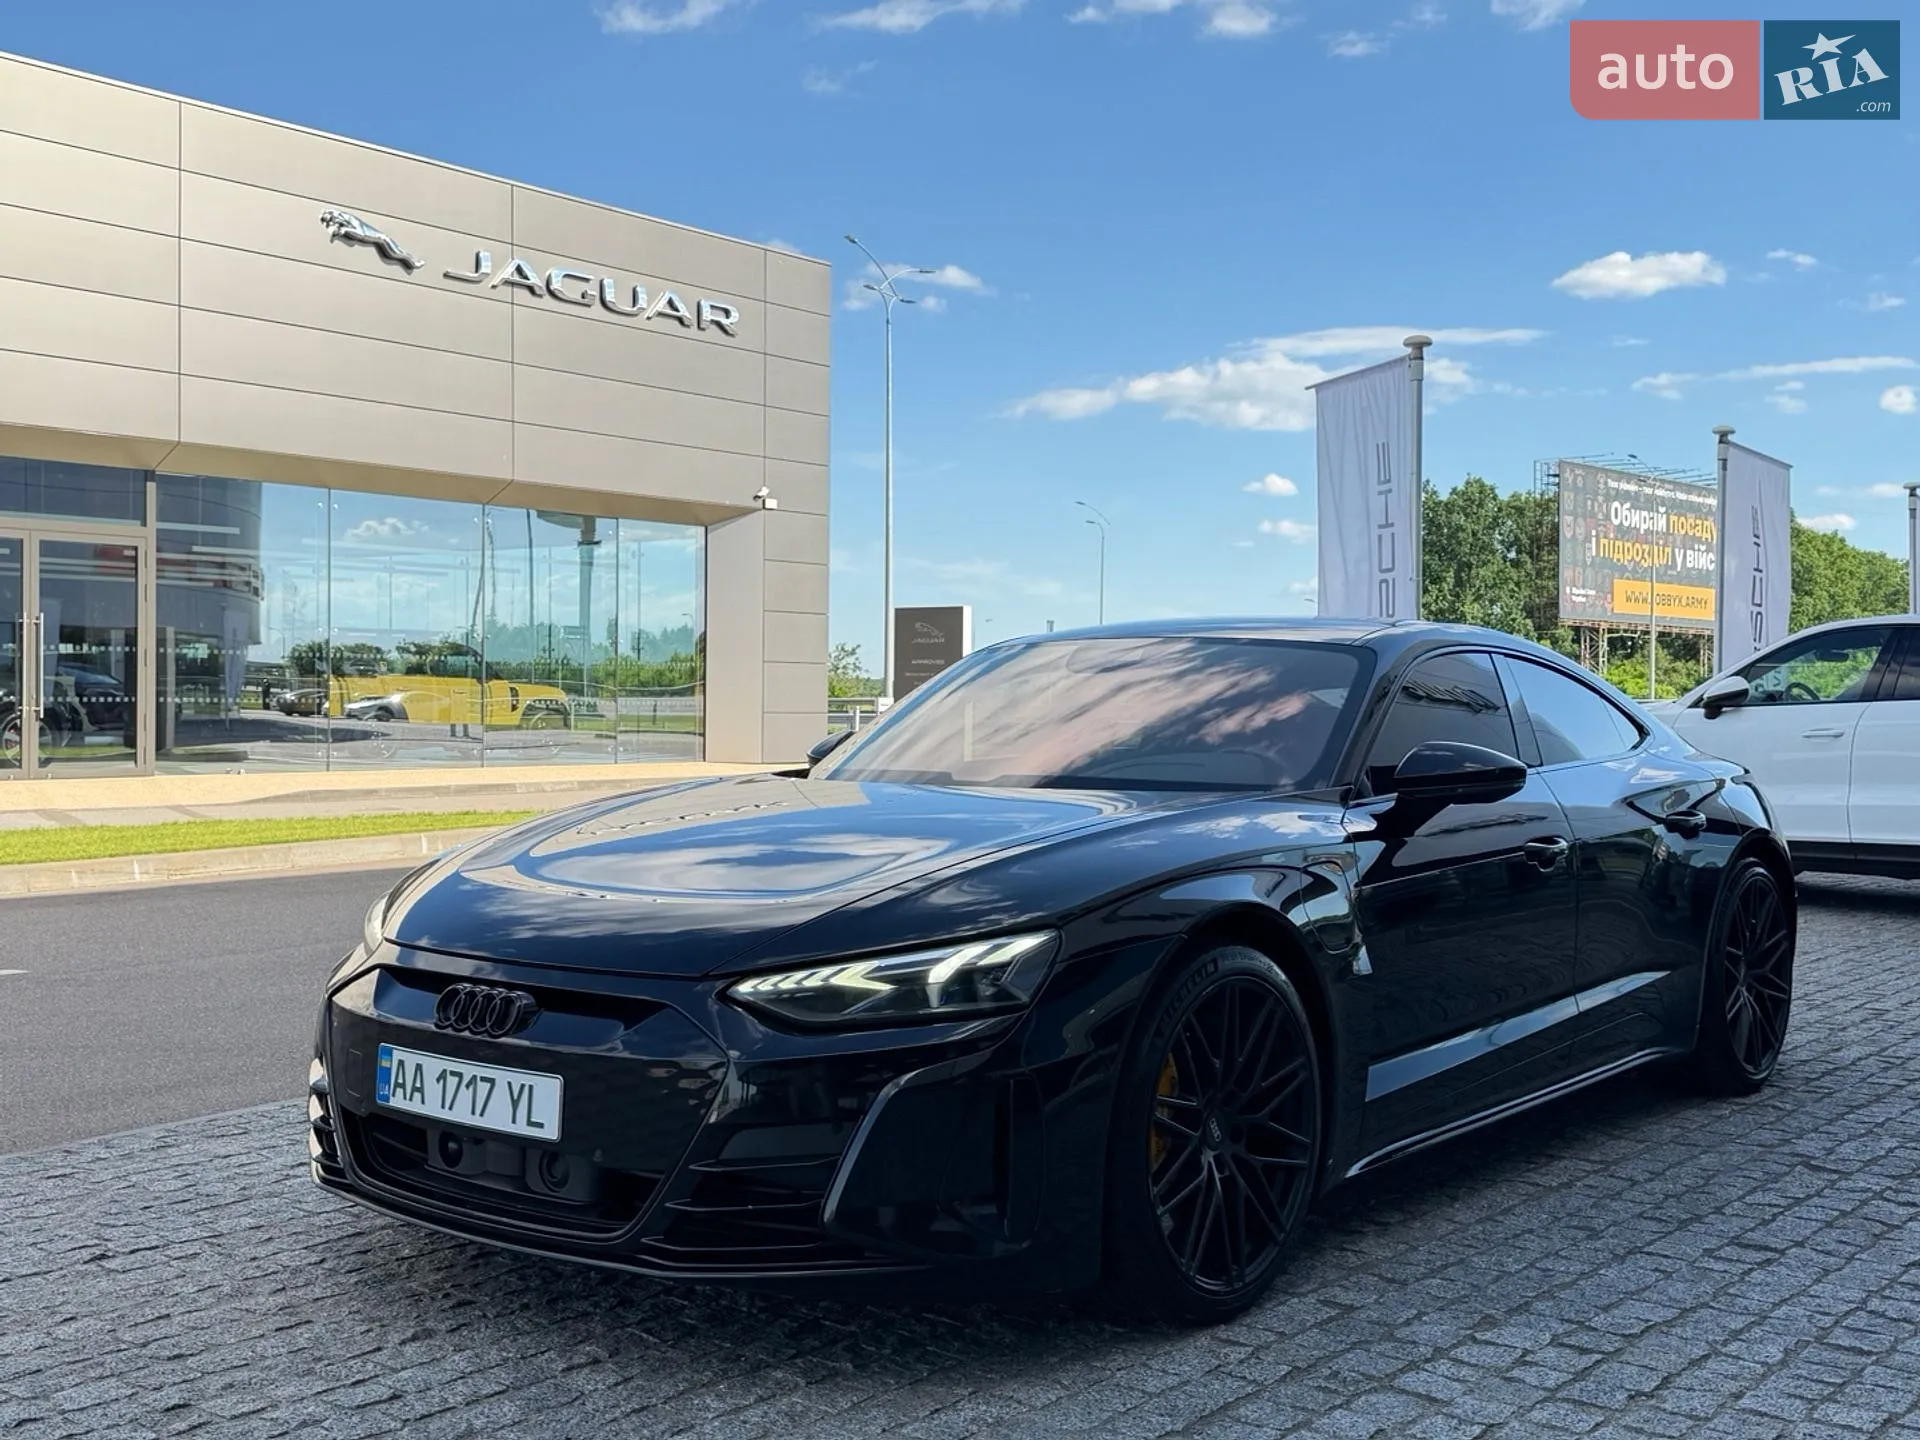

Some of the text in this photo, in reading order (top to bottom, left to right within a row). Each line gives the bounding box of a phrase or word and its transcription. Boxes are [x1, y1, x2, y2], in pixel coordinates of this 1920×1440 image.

[443, 250, 740, 337] JAGUAR
[1625, 590, 1709, 611] WWW.OBBYX.ARMY
[1750, 504, 1763, 652] SCHE
[392, 1059, 545, 1129] AA 1717 YL
